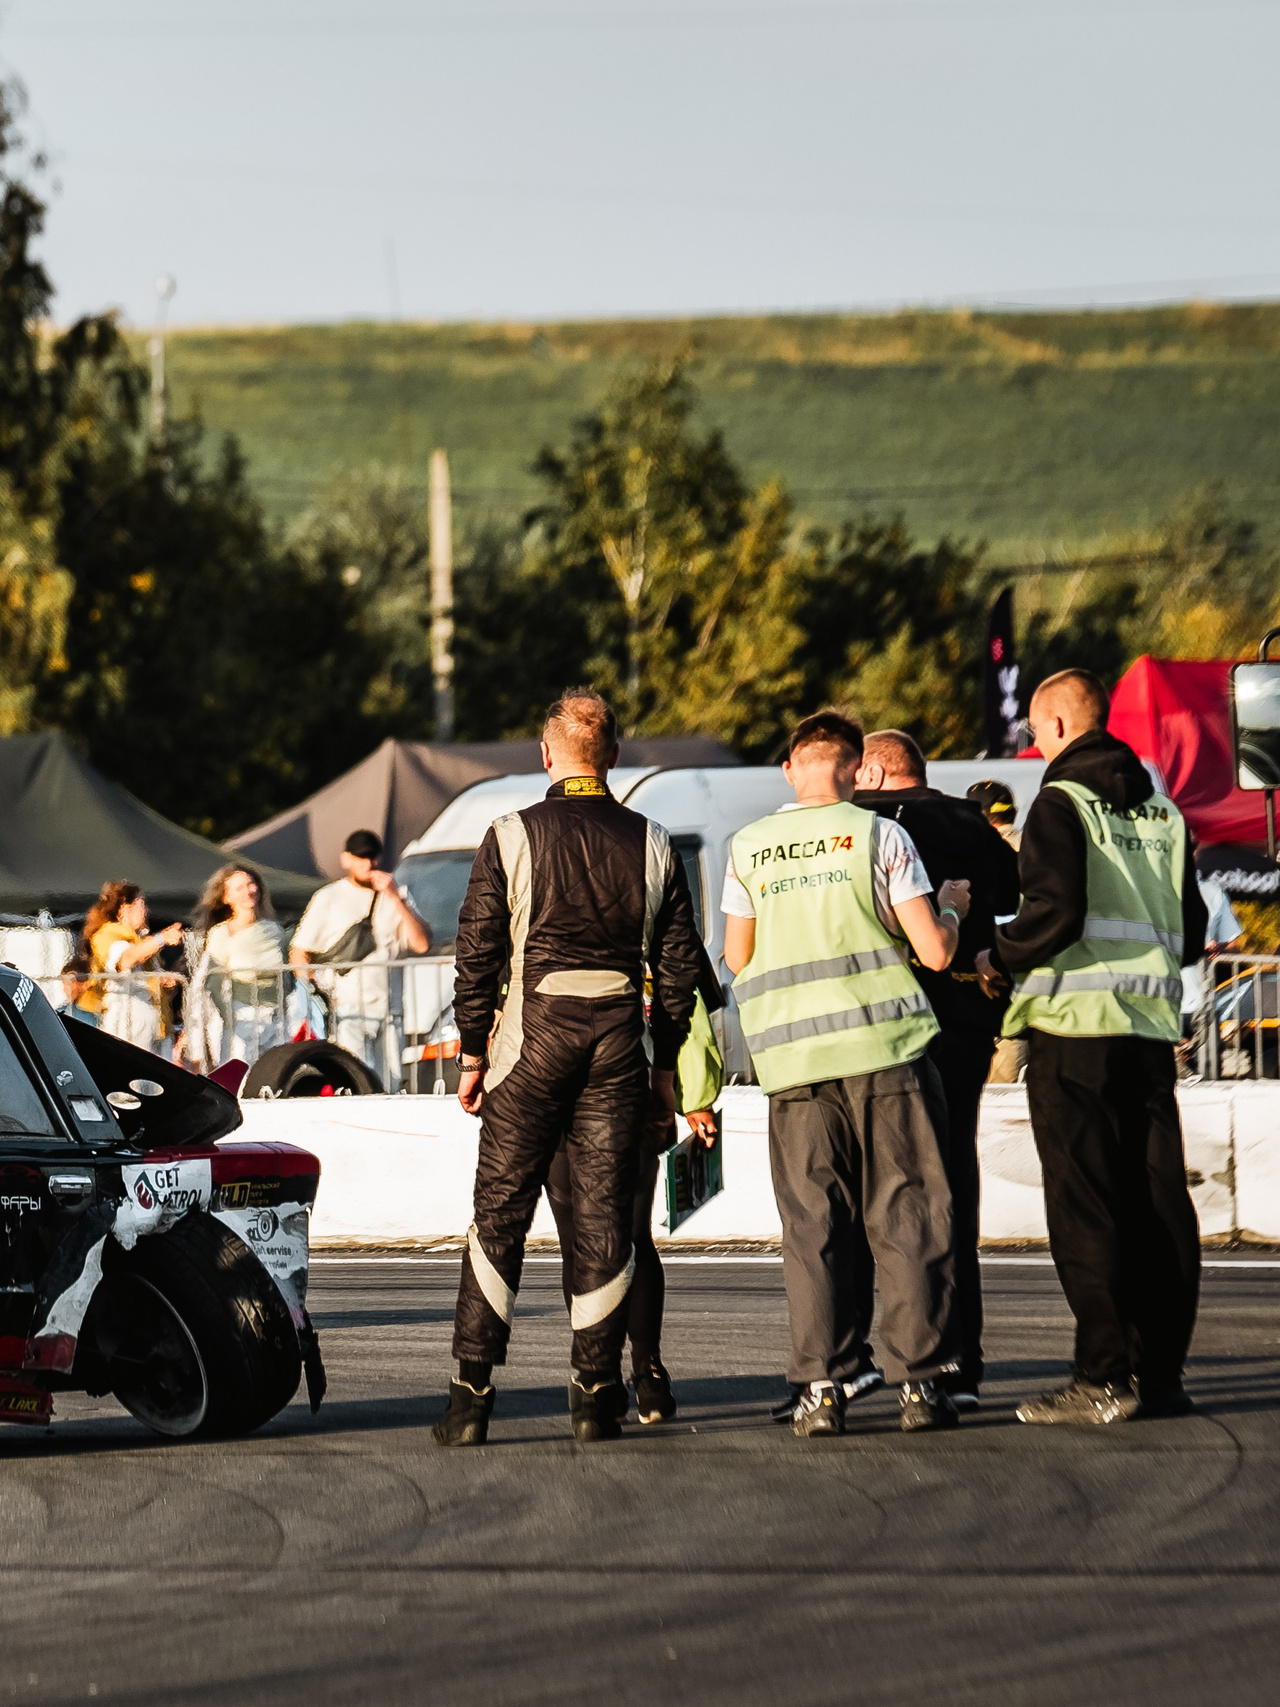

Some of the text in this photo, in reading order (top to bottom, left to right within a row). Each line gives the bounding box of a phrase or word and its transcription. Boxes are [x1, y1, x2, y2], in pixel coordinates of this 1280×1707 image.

[770, 869, 852, 894] GET PETROL
[155, 1167, 180, 1189] GET
[0, 1196, 41, 1211] ФАРЫ
